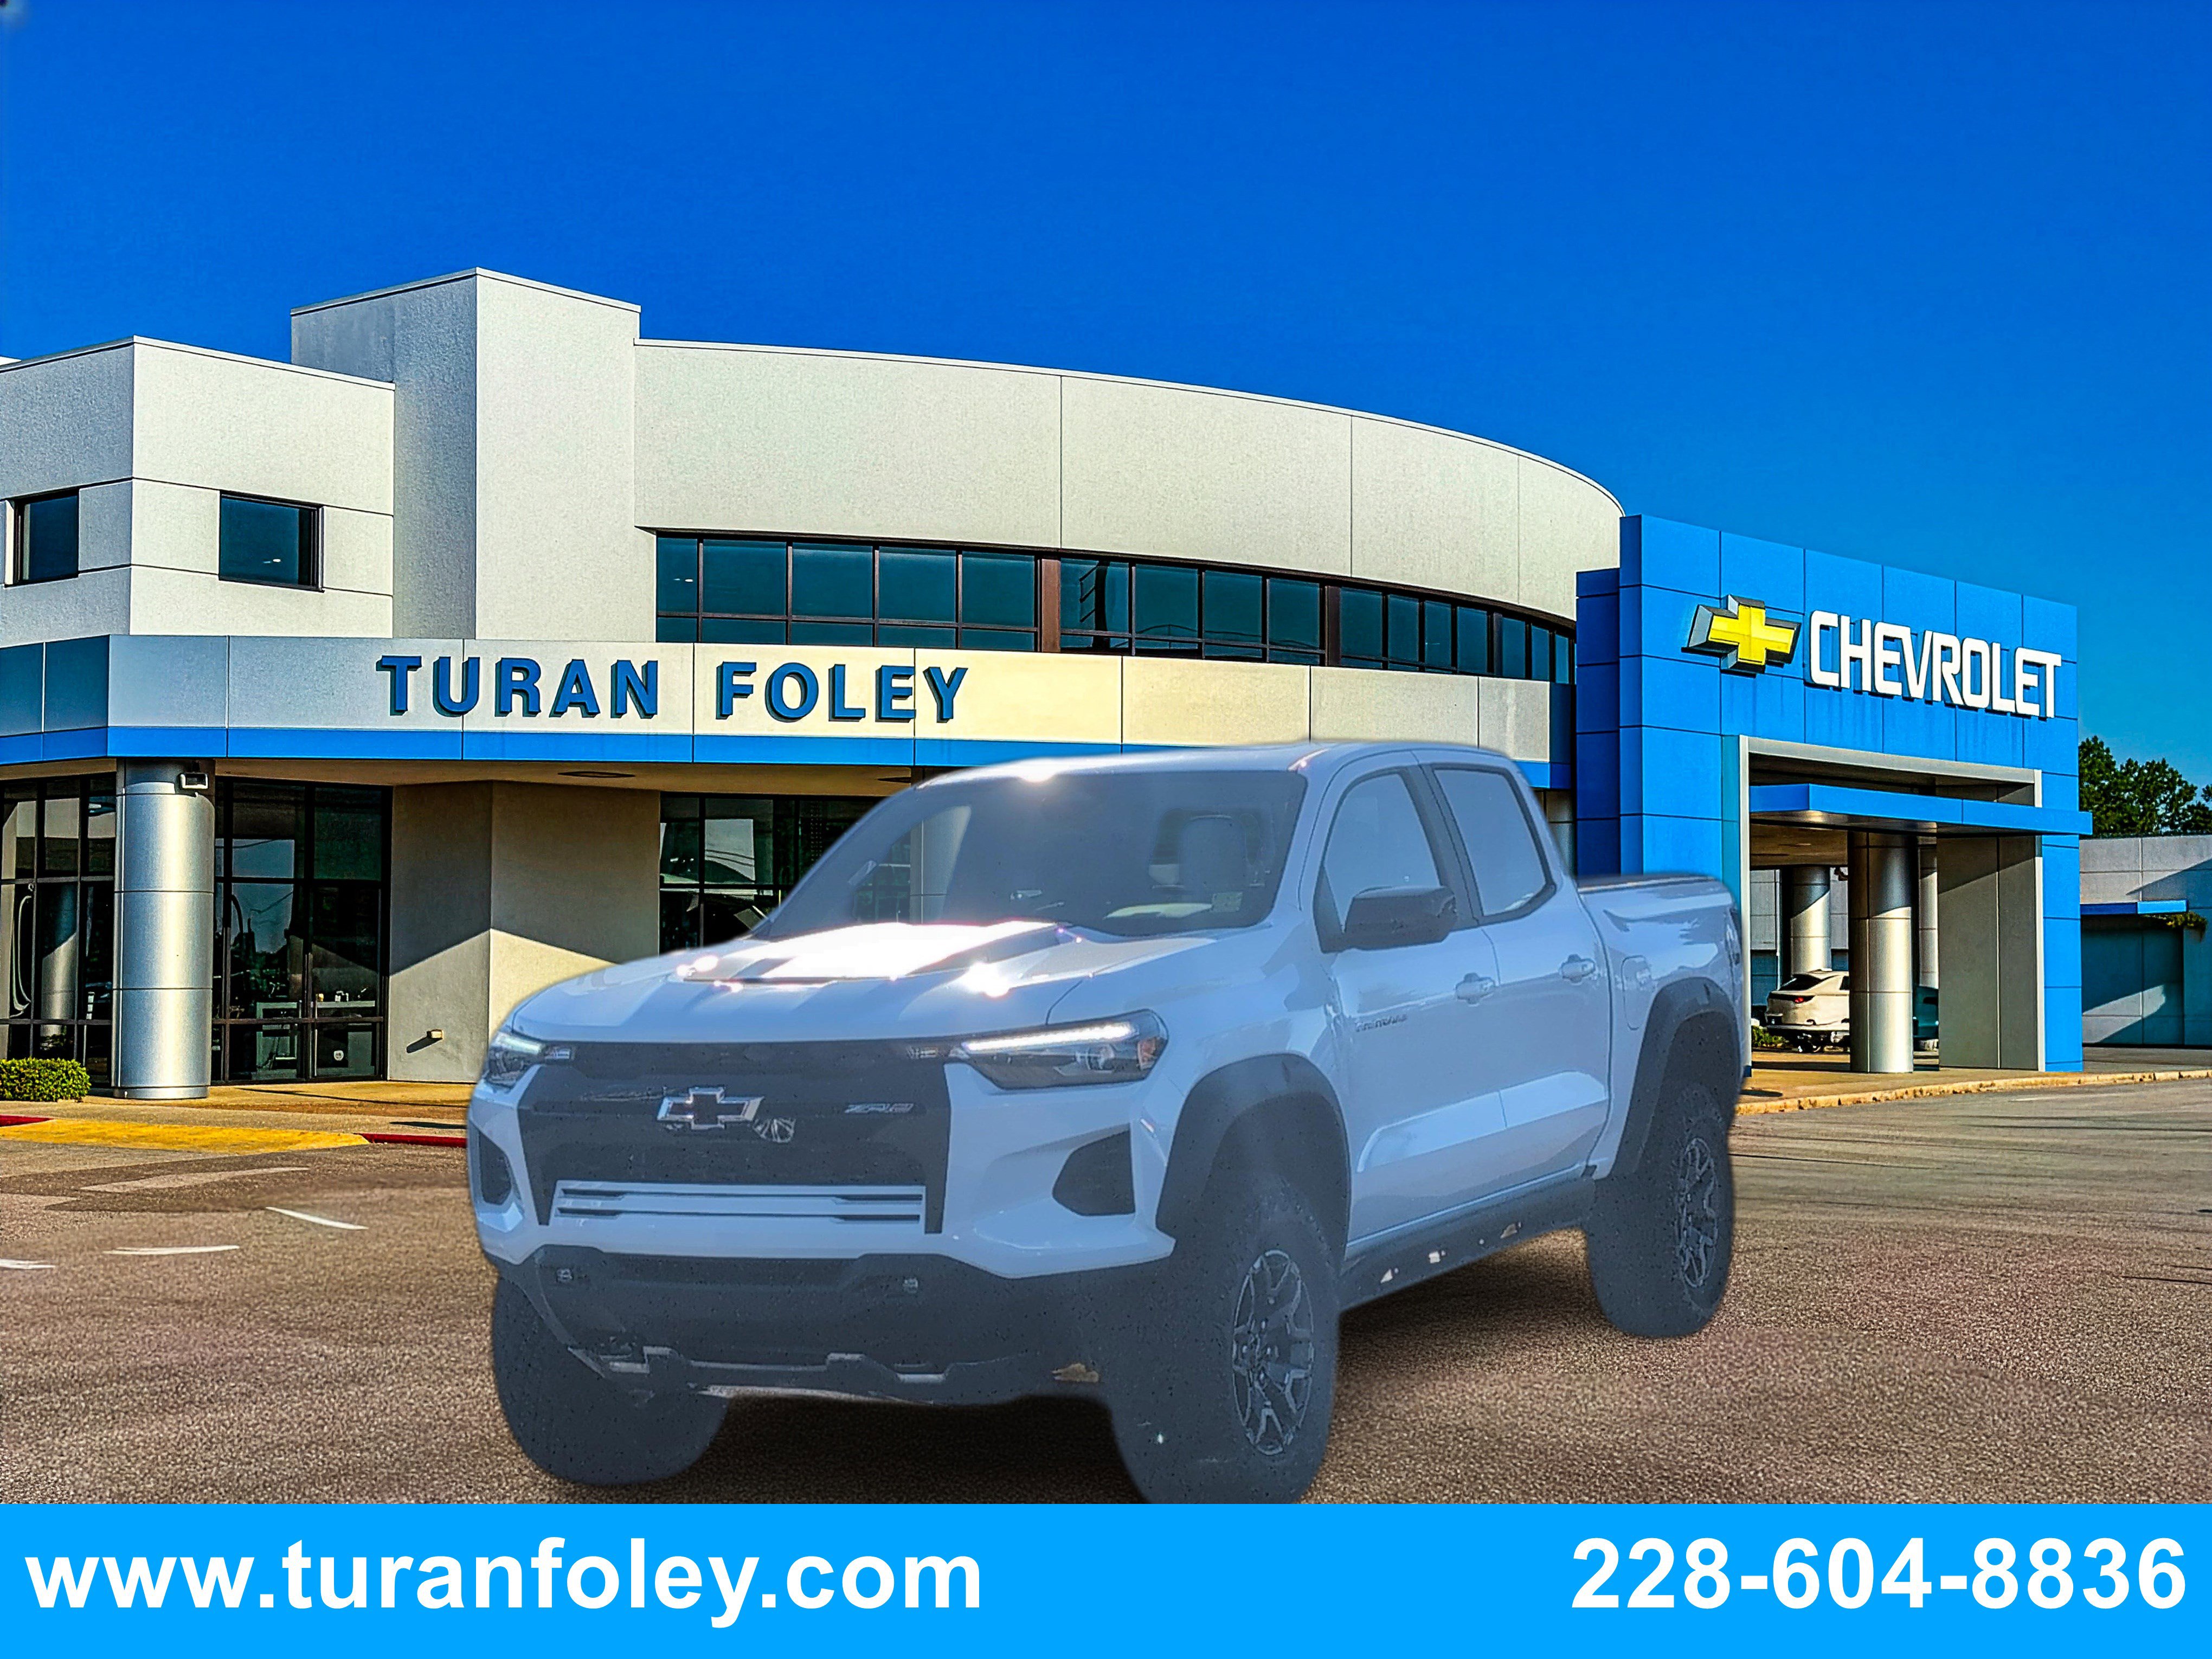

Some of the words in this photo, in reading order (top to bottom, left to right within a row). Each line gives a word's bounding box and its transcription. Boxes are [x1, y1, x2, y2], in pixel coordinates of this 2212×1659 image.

[376, 655, 658, 718] TURAN
[716, 662, 968, 723] FOLEY
[1810, 610, 2062, 718] CHEVROLET
